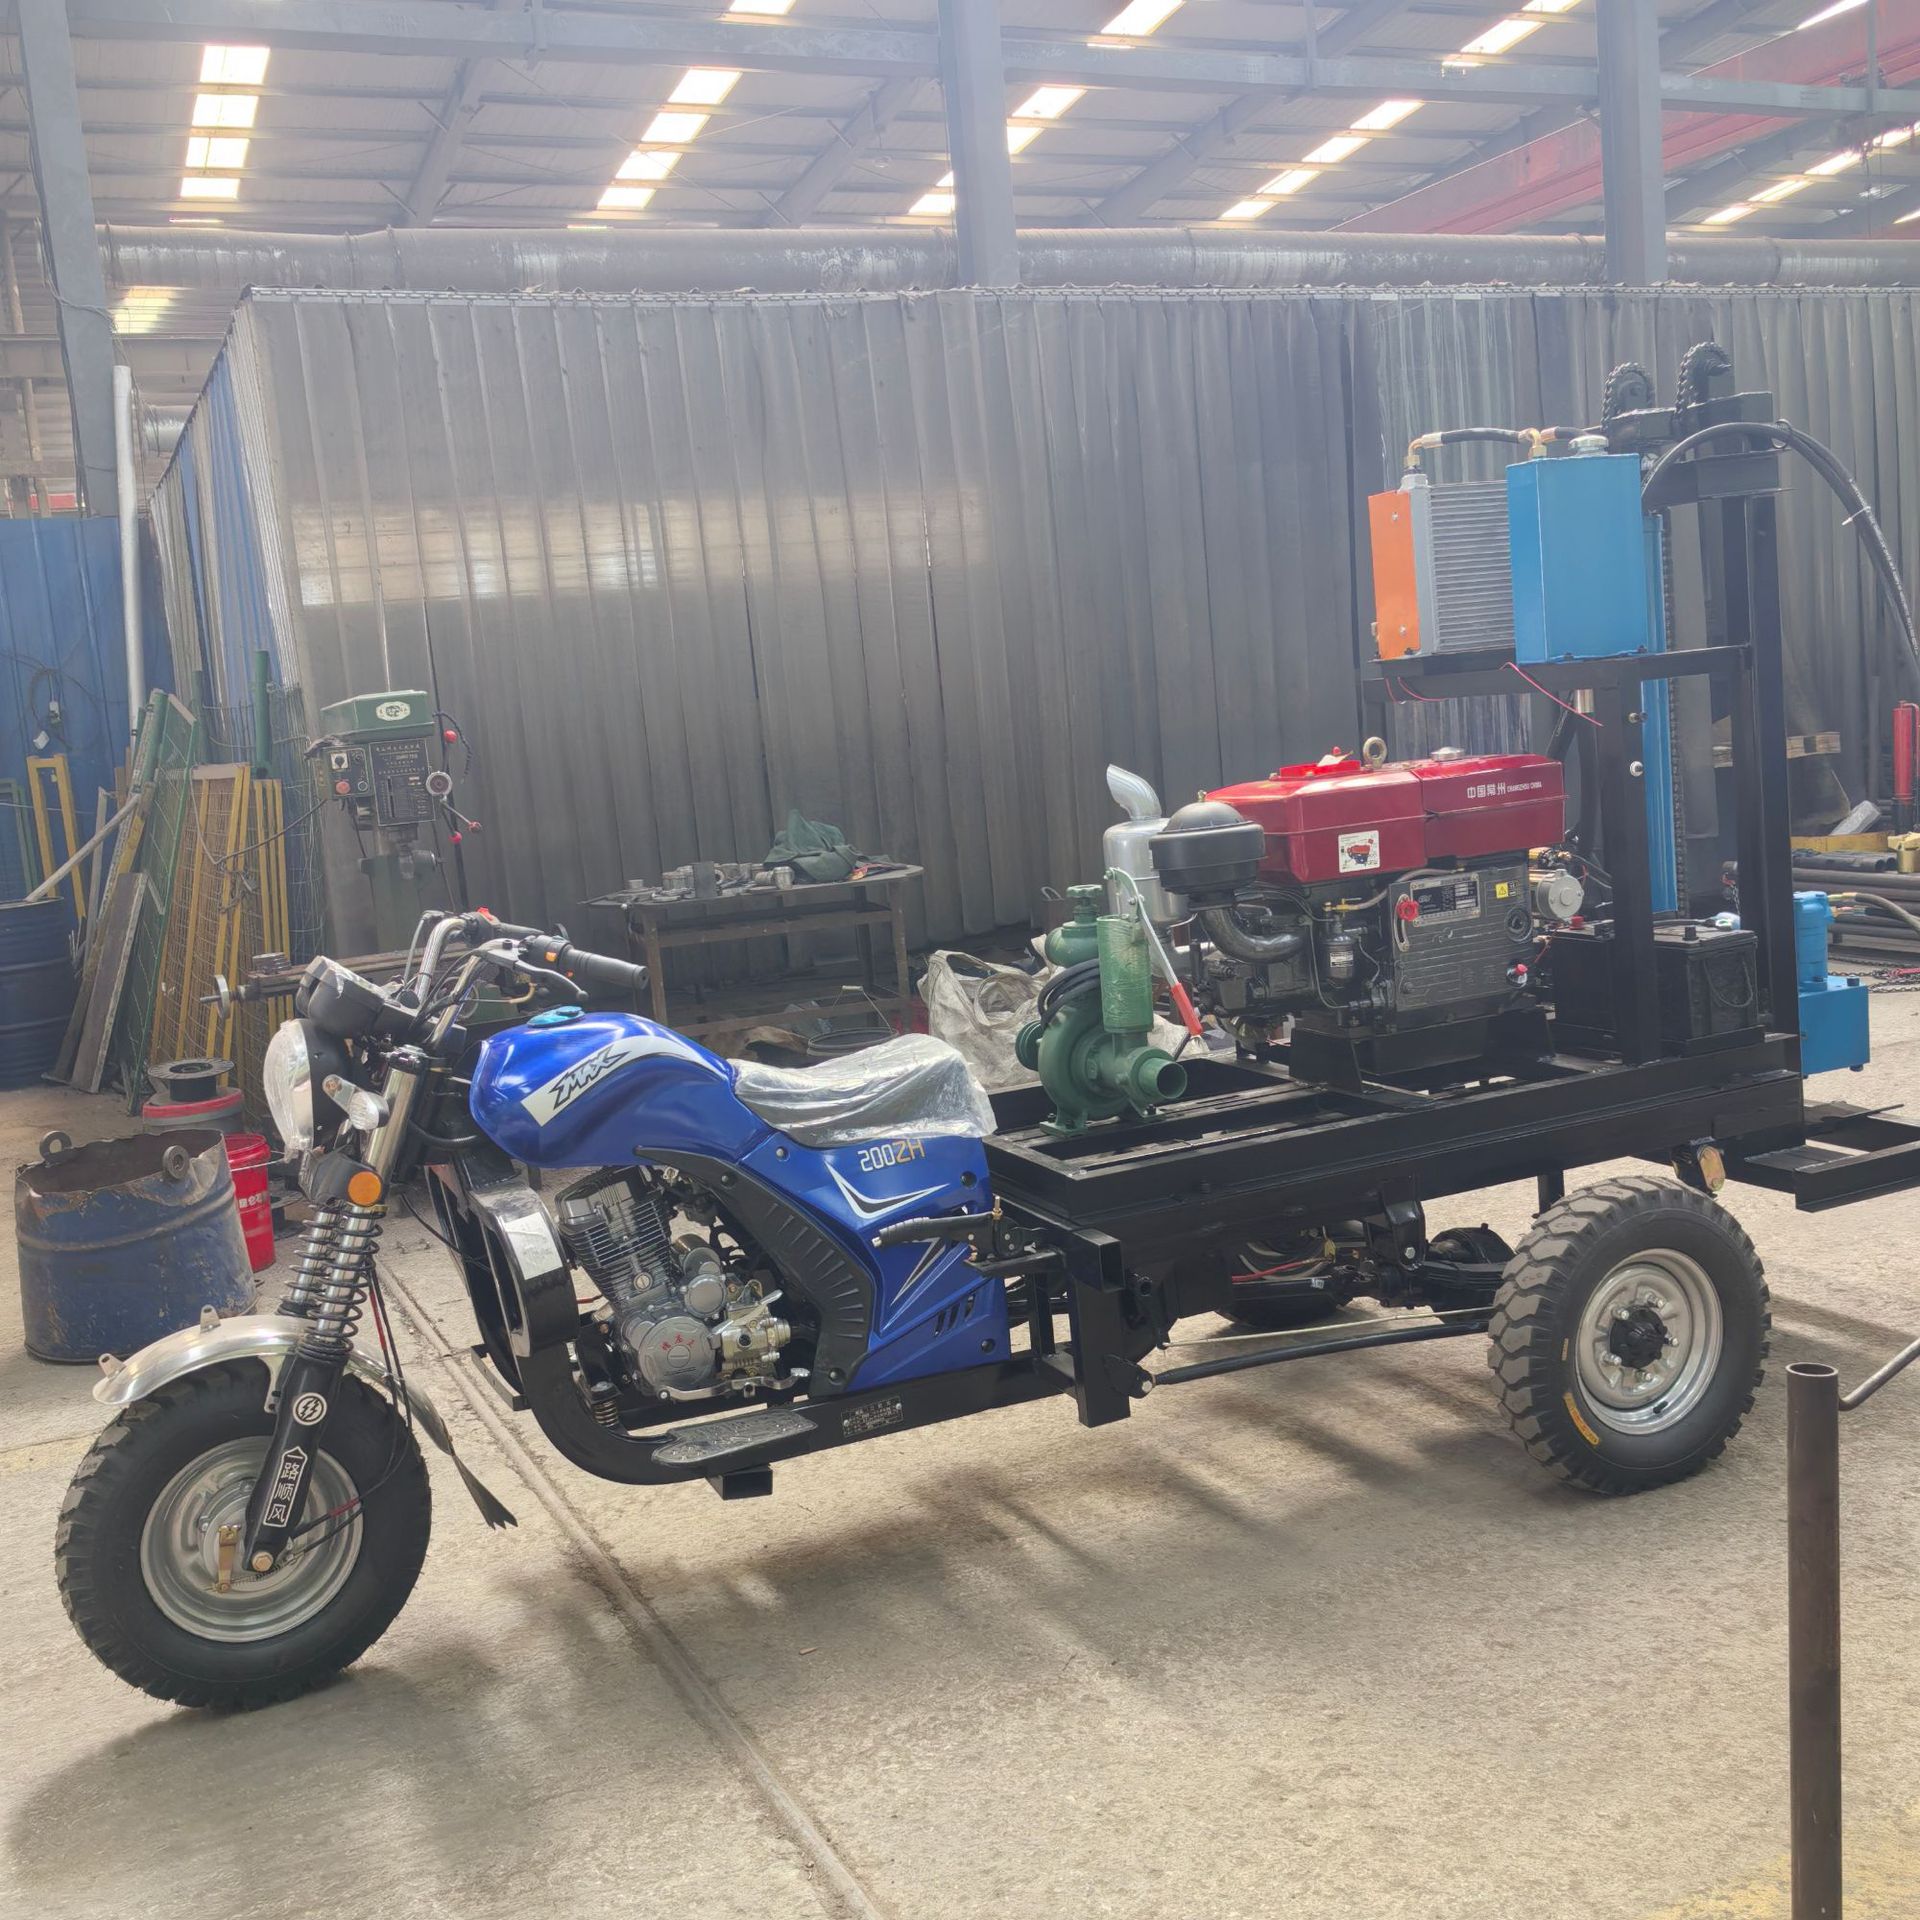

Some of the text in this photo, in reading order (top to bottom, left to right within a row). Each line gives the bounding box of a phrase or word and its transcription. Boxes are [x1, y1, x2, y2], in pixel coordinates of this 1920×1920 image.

[1467, 782, 1506, 799] 中国常州
[857, 1138, 926, 1172] 200ZH
[267, 1454, 304, 1524] 一路顺风
